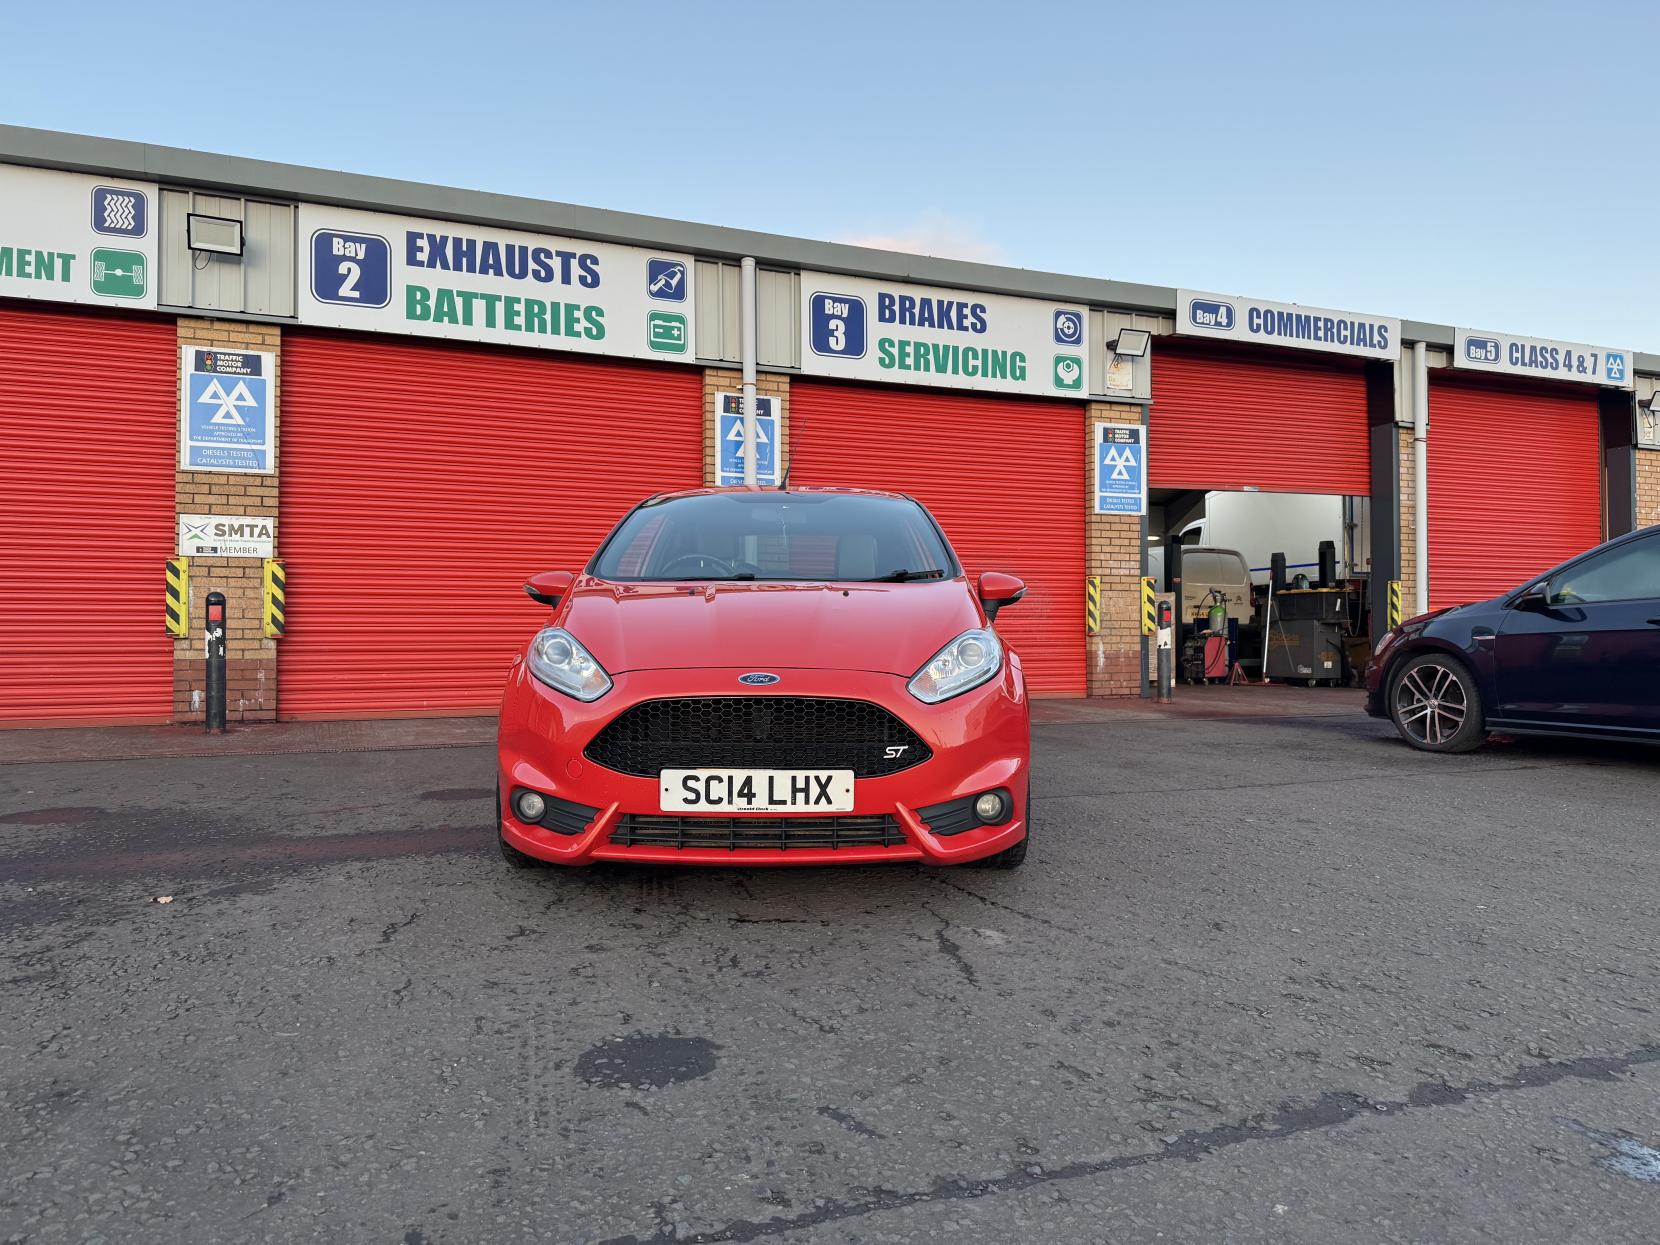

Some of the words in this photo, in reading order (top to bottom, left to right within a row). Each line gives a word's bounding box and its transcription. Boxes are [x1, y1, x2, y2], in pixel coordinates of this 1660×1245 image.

[332, 237, 367, 260] Bay
[405, 230, 601, 289] EXHAUSTS
[338, 261, 360, 298] 2
[405, 284, 606, 341] BATTERIES
[824, 298, 849, 318] Bay
[878, 292, 987, 334] BRAKES
[828, 319, 846, 351] 3
[1248, 307, 1389, 350] COMMERCIALS
[216, 366, 251, 374] COMPANY
[878, 337, 1027, 382] SERVICING
[1508, 342, 1560, 371] CLASS
[1562, 350, 1573, 372] 4
[1577, 354, 1588, 375] &
[1590, 353, 1598, 375] 7
[197, 457, 233, 465] CATALYSTS
[213, 523, 272, 539] SMTA
[219, 546, 258, 554] MEMBER
[883, 745, 909, 758] ST
[681, 775, 756, 806] SC14
[768, 775, 833, 806] LHX
